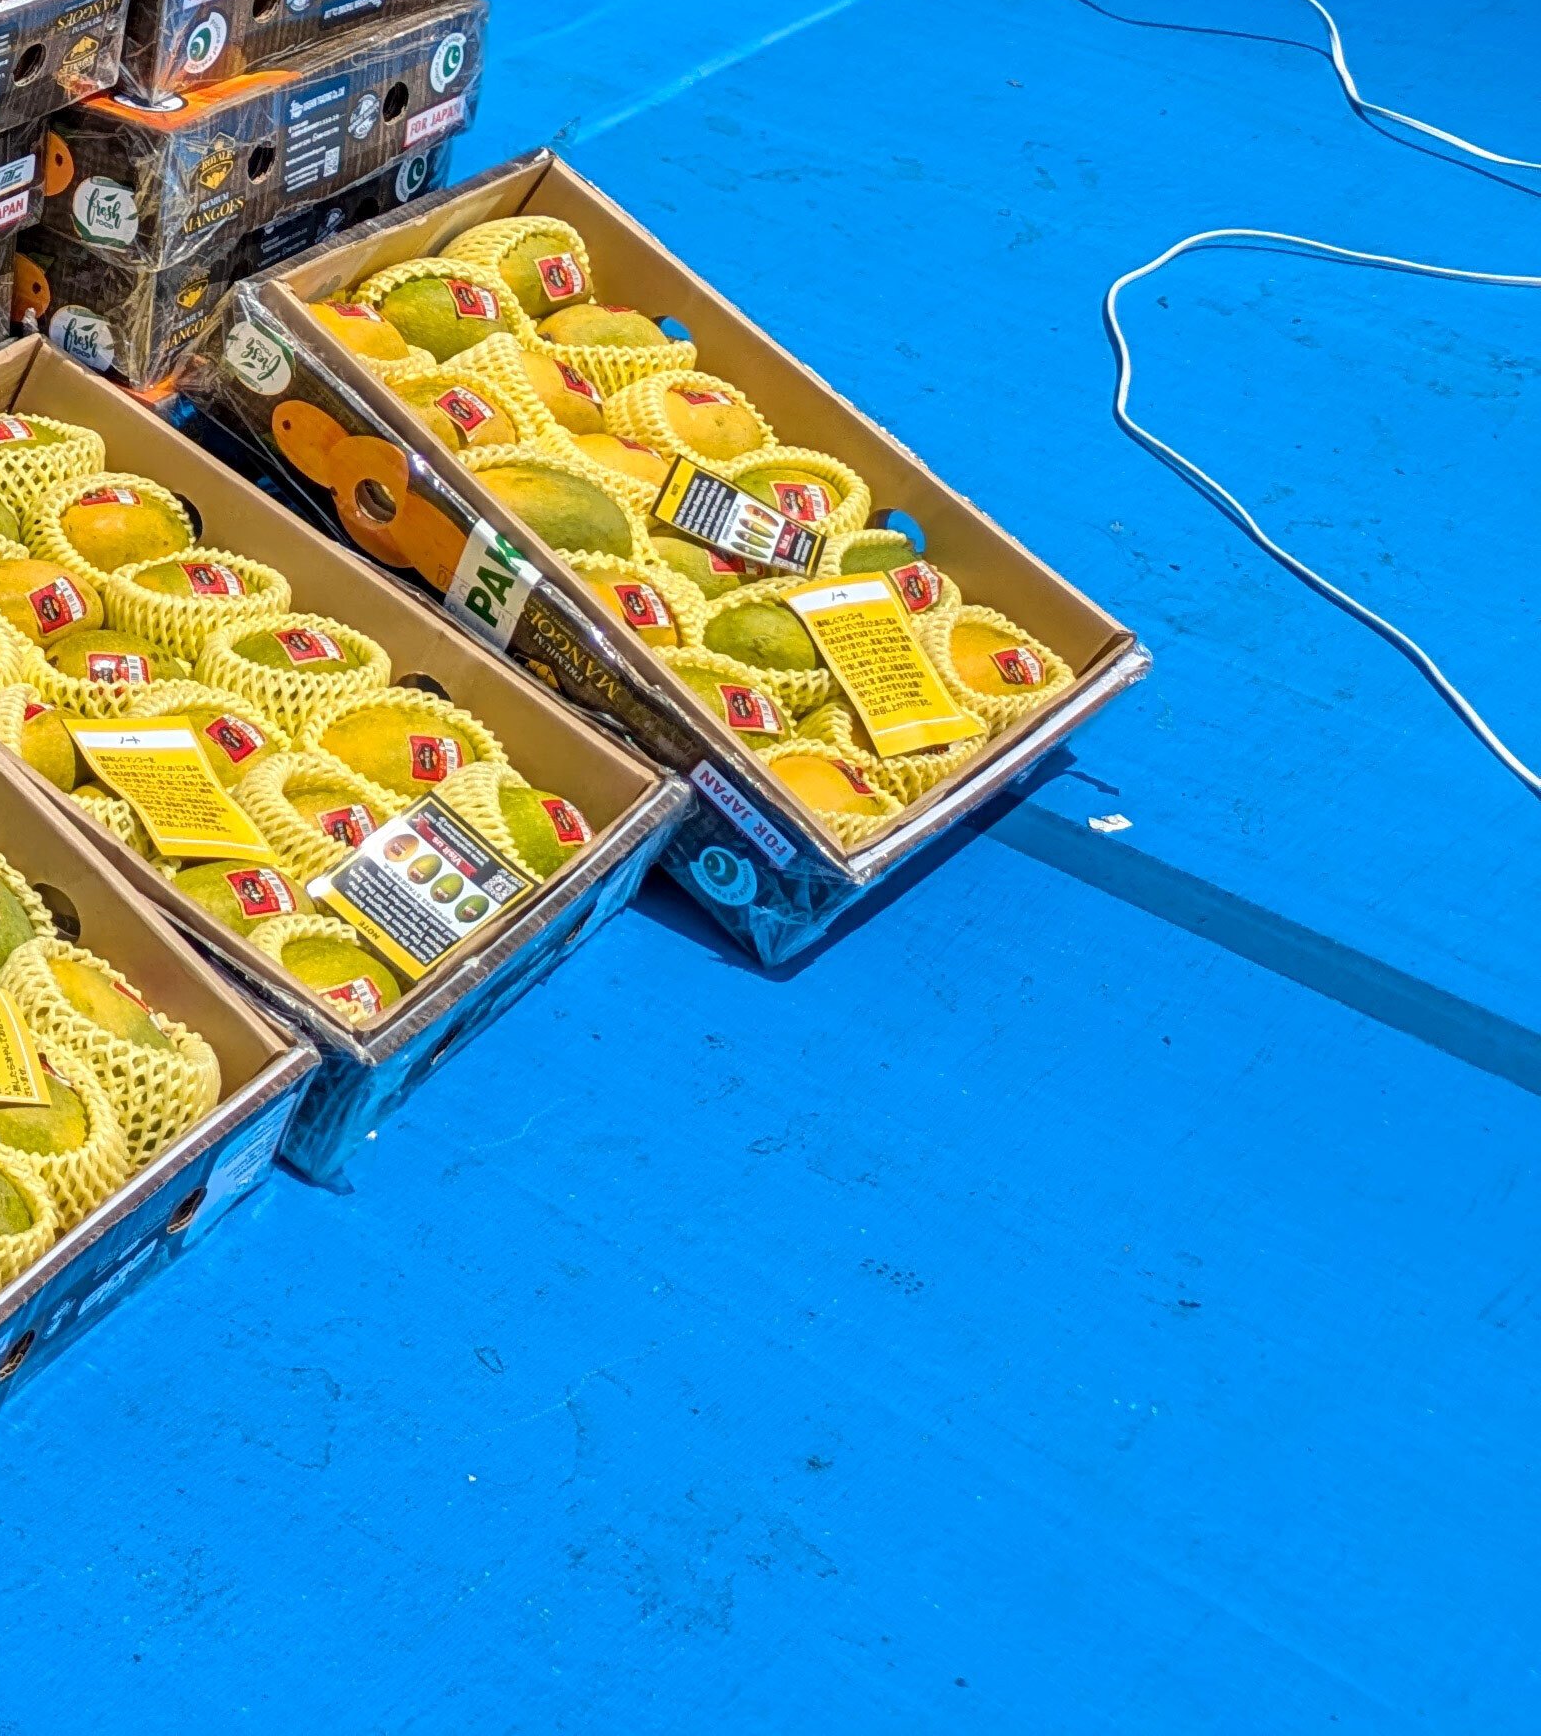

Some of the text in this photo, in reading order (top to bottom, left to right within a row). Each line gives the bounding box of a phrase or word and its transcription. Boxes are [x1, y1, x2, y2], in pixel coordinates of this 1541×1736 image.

[411, 98, 463, 135] FOR JAPAN
[86, 191, 123, 230] fresh
[64, 323, 99, 359] fresh
[241, 337, 280, 384] fresh
[465, 535, 522, 628] PAK
[534, 632, 584, 683] PREMIUM
[696, 766, 793, 862] FOR JAPAN
[441, 842, 464, 869] Visit
[357, 916, 382, 943] NOTE
